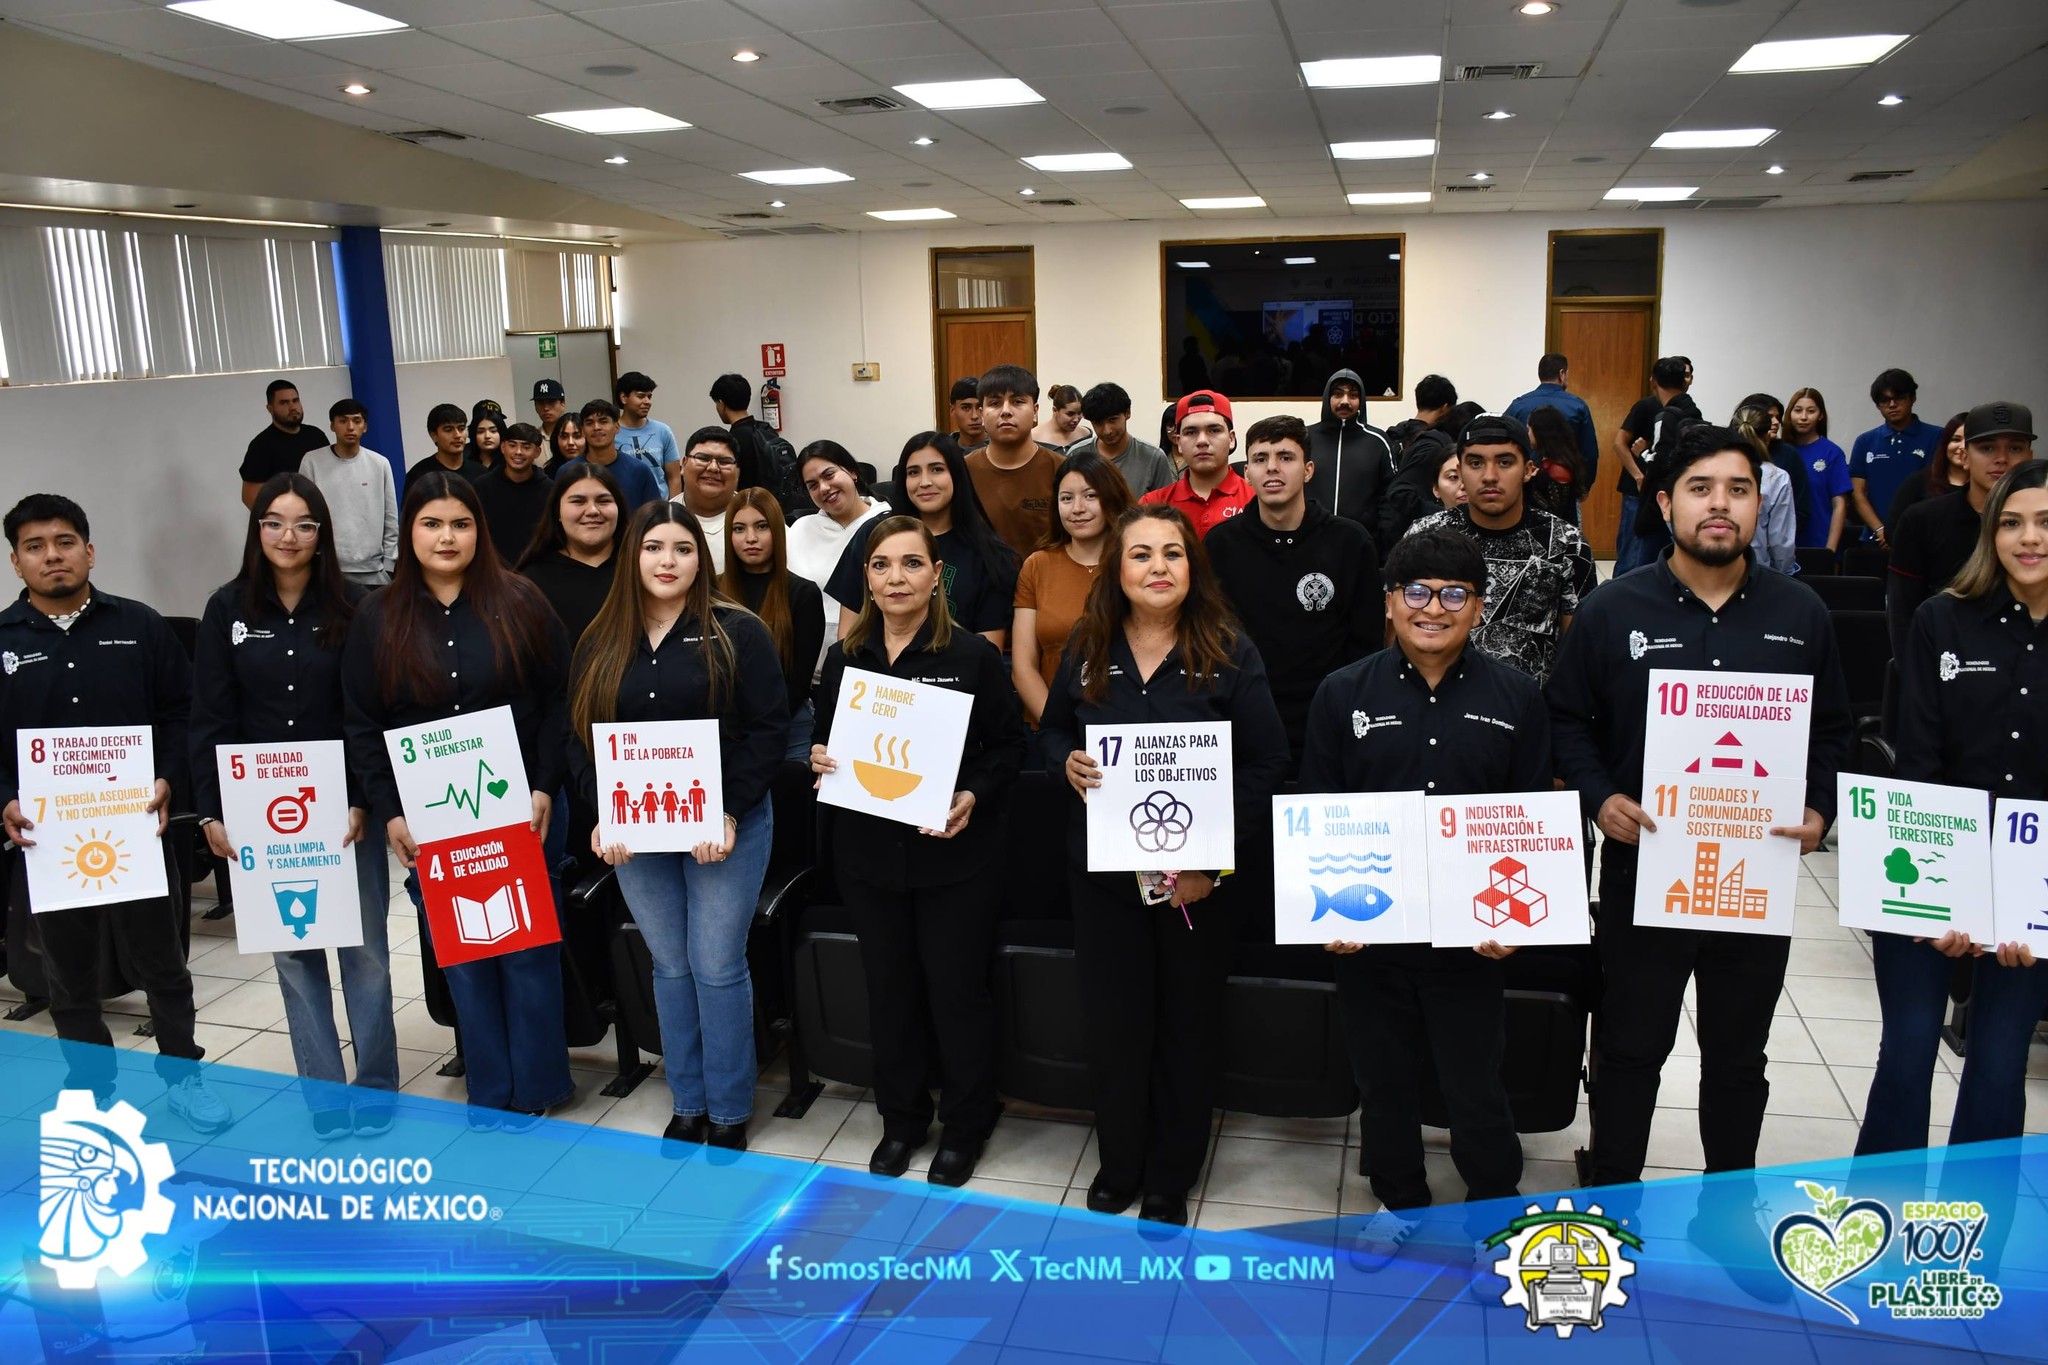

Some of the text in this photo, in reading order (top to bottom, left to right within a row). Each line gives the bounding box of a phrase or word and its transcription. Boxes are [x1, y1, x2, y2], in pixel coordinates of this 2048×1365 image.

[850, 680, 866, 710] 2
[875, 685, 916, 706] HAMBRE
[1658, 682, 1689, 716] 10
[1697, 684, 1808, 703] REDUCCIÓN DE LAS
[872, 702, 898, 719] CERO
[1696, 703, 1792, 722] DESIGUALDADES
[53, 735, 143, 749] TRABAJO DECENTE
[421, 729, 452, 746] SALUD
[623, 733, 637, 745] FIN
[1135, 734, 1218, 750] ALIANZAS PARA
[31, 738, 46, 763] 8
[53, 749, 126, 762] Y CRECIMIENTO
[401, 737, 417, 764] 3
[425, 737, 484, 760] Y BIENESTAR
[608, 734, 618, 761] 1
[624, 747, 694, 760] DE LA POBREZA
[1098, 736, 1122, 767] 17
[231, 755, 246, 780] 5
[256, 752, 303, 764] IGUALDAD
[1135, 752, 1177, 766] LOGRAR
[54, 762, 111, 776] ECONÓMICO
[258, 765, 309, 779] DE GÉNERO
[1135, 768, 1217, 782] LOS OBJETIVOS
[55, 787, 150, 807] ENERGÍA ASEQUIBLE
[1655, 784, 1678, 817] 11
[1690, 786, 1760, 804] CIUDADES Y
[1849, 786, 1876, 820] 15
[1887, 791, 1913, 807] VIDA
[34, 797, 46, 824] 7
[57, 802, 150, 822] Y NO CONTAMINANT
[1324, 805, 1350, 818] VIDA
[1465, 805, 1528, 820] INDUSTRIA,
[1688, 804, 1773, 822] COMUNIDADES
[1284, 806, 1311, 837] 14
[1324, 822, 1391, 836] SUBMARINA
[1440, 807, 1457, 839] 9
[1466, 820, 1544, 837] INNOVACIÓN E
[1888, 809, 1977, 832] DE ECOSISTEMAS
[2007, 811, 2039, 844] 16
[1687, 821, 1764, 840] SOSTENIBLES
[1888, 826, 1954, 846] TERRESTRES
[267, 842, 326, 856] AGUA LIMPIA
[450, 840, 504, 864] EDUCACIÓN
[1468, 837, 1574, 854] INFRAESTRUCTURA
[240, 846, 256, 871] 6
[268, 854, 341, 869] Y SANEAMIENTO
[429, 854, 445, 882] 4
[454, 856, 509, 878] DE CALIDAD
